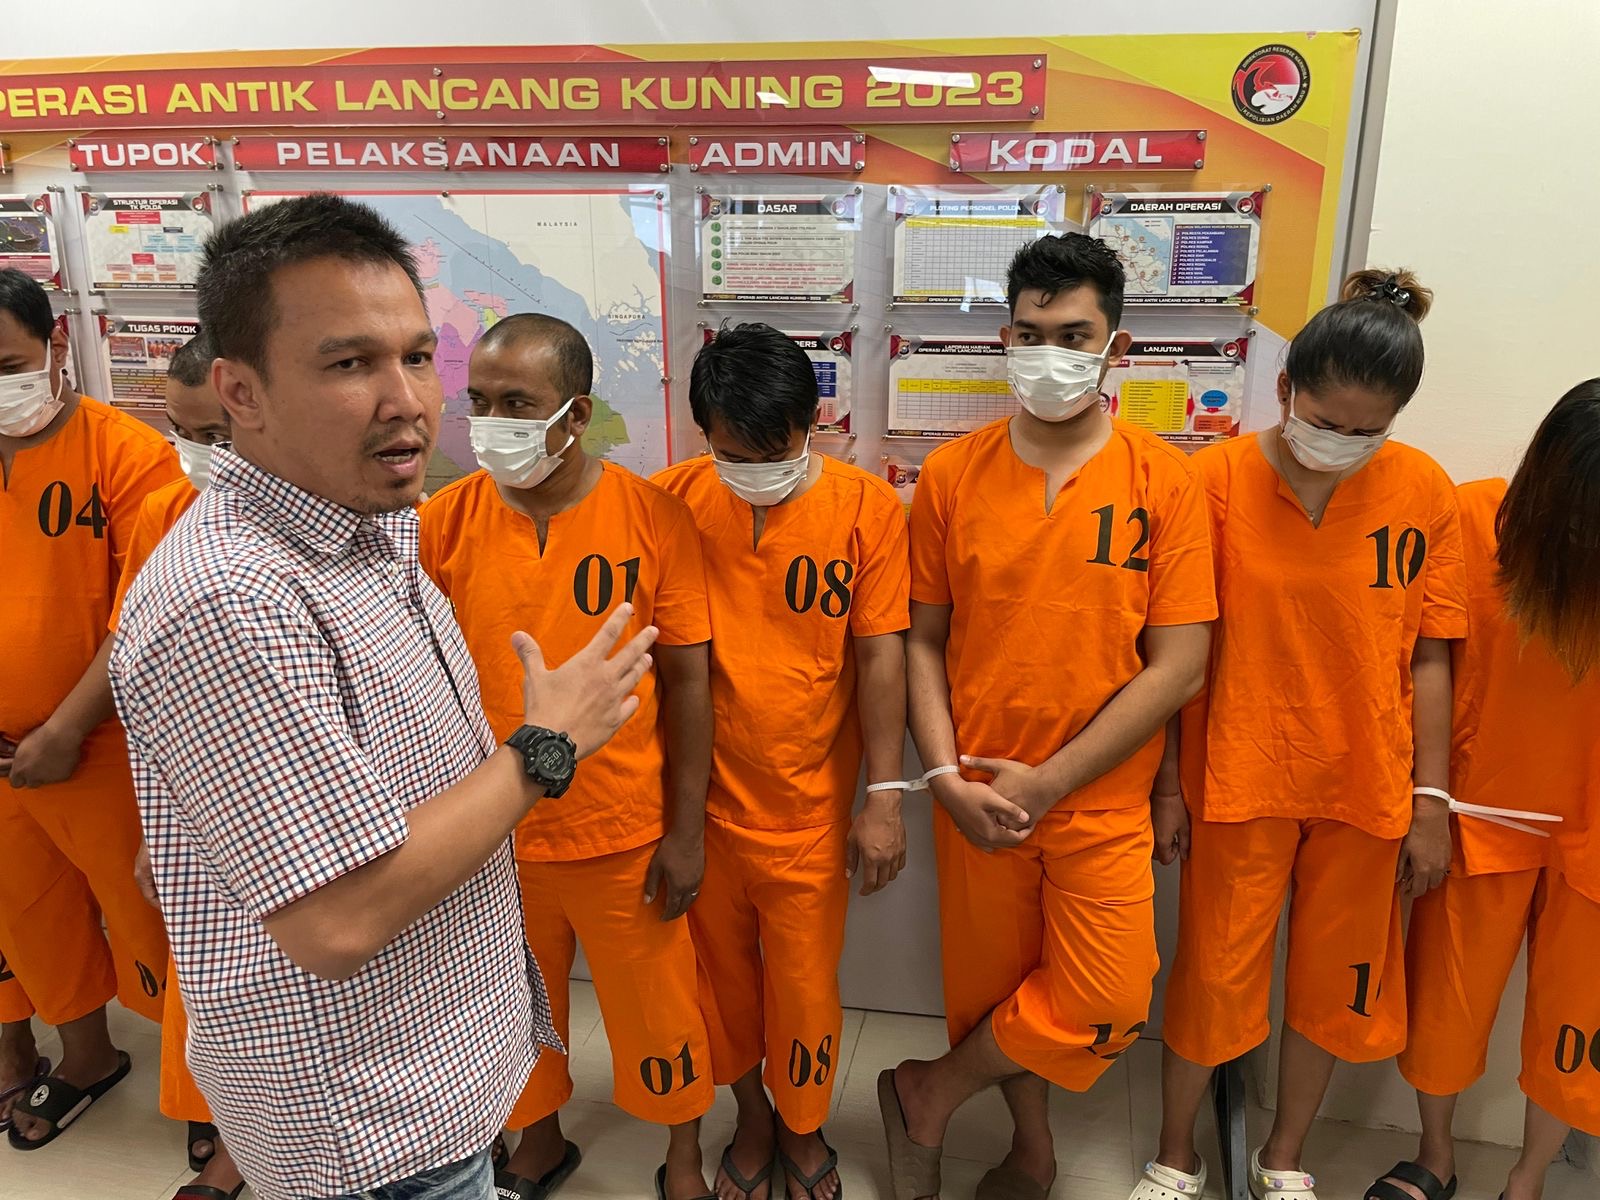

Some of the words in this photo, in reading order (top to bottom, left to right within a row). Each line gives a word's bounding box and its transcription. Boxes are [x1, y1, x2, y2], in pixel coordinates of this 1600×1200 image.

[165, 80, 318, 114] ANTIK
[335, 77, 600, 111] LANCANG
[620, 74, 844, 111] KUNING
[865, 69, 1024, 109] 2023
[77, 142, 207, 167] TUPOK
[277, 141, 620, 168] PELAKSANAAN
[700, 140, 852, 168] ADMIN
[989, 136, 1163, 165] KODAL
[757, 204, 797, 214] DASAR
[1130, 202, 1175, 212] DAERAH
[1175, 202, 1222, 211] OPERASI
[128, 324, 161, 333] TUGAS
[162, 325, 197, 334] POKOK
[38, 480, 108, 539] 04
[1086, 503, 1150, 572] 12
[1365, 525, 1426, 590] 10
[573, 553, 640, 617] 01
[784, 554, 854, 618] 08
[134, 959, 167, 998] 0
[639, 1041, 701, 1096] 01
[788, 1033, 832, 1088] 08
